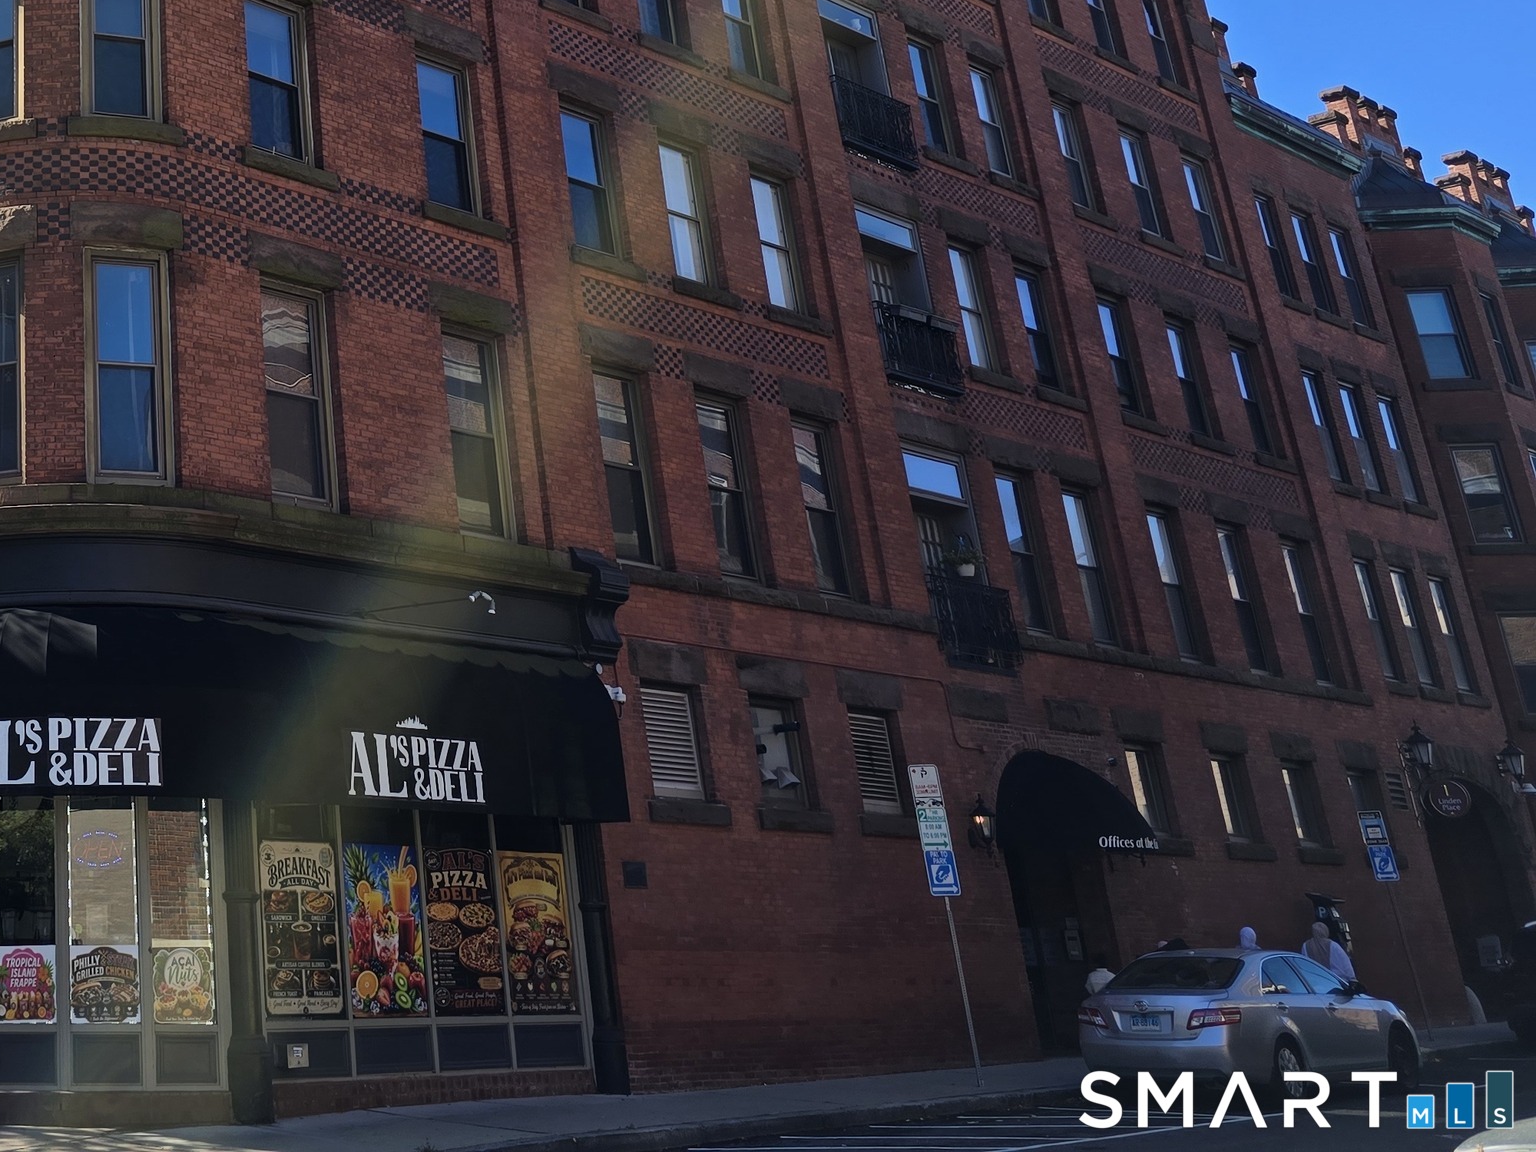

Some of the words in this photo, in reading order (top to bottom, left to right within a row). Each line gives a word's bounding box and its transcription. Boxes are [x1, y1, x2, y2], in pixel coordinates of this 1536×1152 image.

[48, 717, 161, 752] PIZZA
[410, 735, 483, 772] PIZZA
[348, 731, 410, 798] AL'S
[919, 810, 927, 822] 2
[1098, 835, 1135, 849] Offices
[1135, 837, 1144, 849] at
[932, 857, 948, 865] PARK
[940, 850, 949, 858] TO
[441, 851, 485, 872] AL'S
[267, 857, 332, 889] BREAKFAST
[430, 870, 488, 890] PIZZA
[286, 878, 298, 887] ALL
[439, 887, 478, 902] DELI
[1318, 906, 1326, 918] P
[5, 957, 41, 967] TROPICAL
[73, 954, 102, 972] PHILLY
[10, 967, 37, 978] ISLAND
[76, 966, 105, 982] GRILLED
[105, 967, 136, 981] CHICKEN
[168, 965, 199, 985] Nuts
[9, 977, 37, 988] FRAPPE
[454, 999, 475, 1009] GREAT
